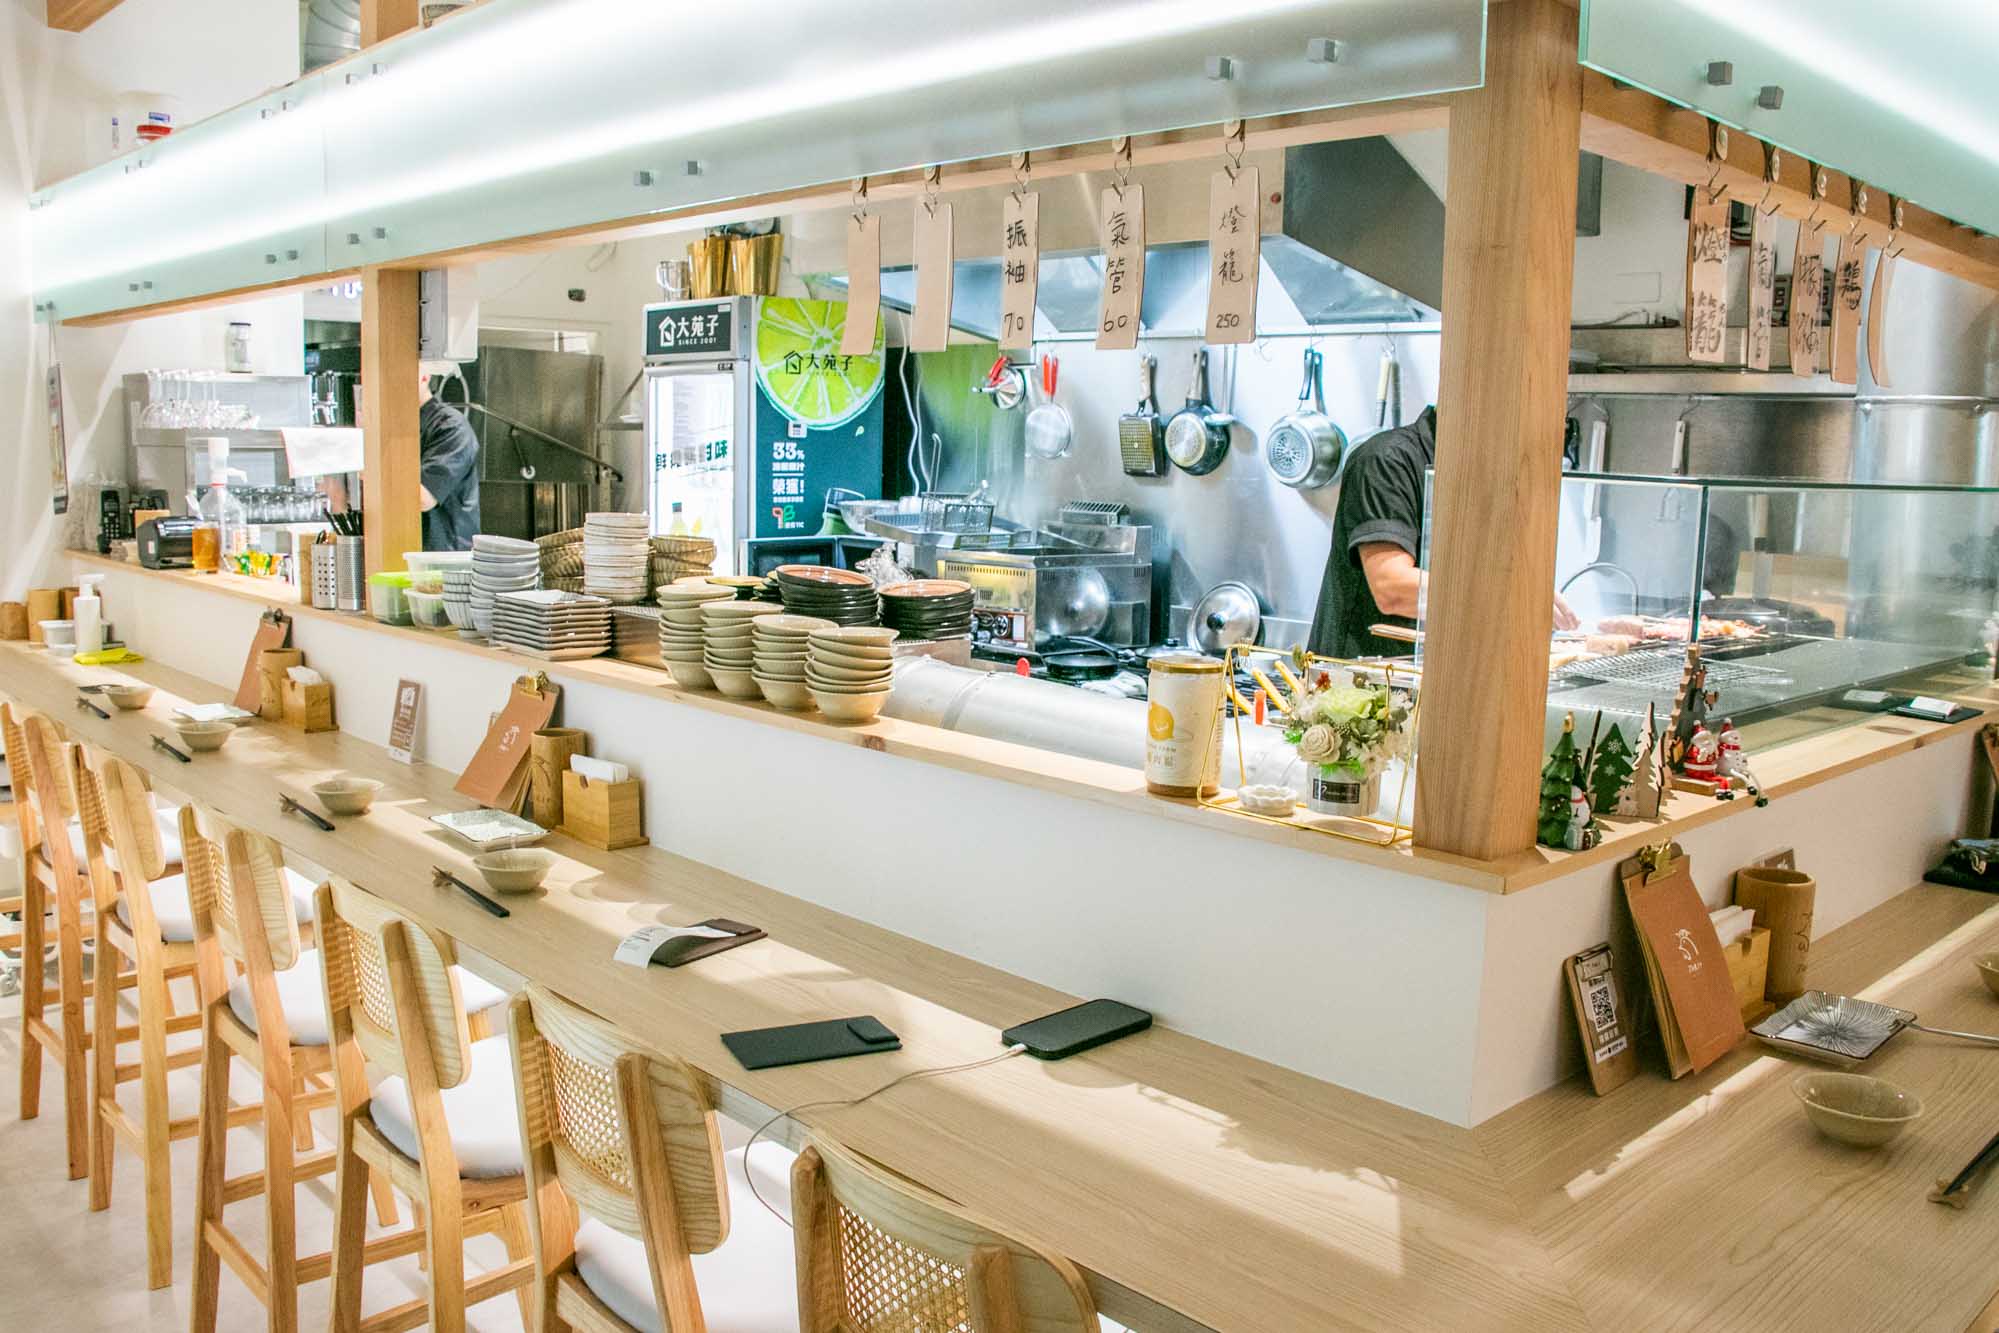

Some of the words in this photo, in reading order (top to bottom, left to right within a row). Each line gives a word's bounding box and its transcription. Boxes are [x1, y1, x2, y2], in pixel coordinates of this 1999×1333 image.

[1004, 218, 1028, 285] 振袖
[1105, 211, 1130, 295] 氣管
[1218, 204, 1246, 287] 燈籠
[676, 314, 720, 339] 大苑子
[1003, 312, 1025, 338] 70
[1103, 310, 1128, 334] 60
[1215, 313, 1240, 330] 250
[678, 338, 697, 346] SINCE
[700, 337, 717, 345] 2001
[806, 353, 853, 373] 大苑子
[772, 441, 805, 461] 33%
